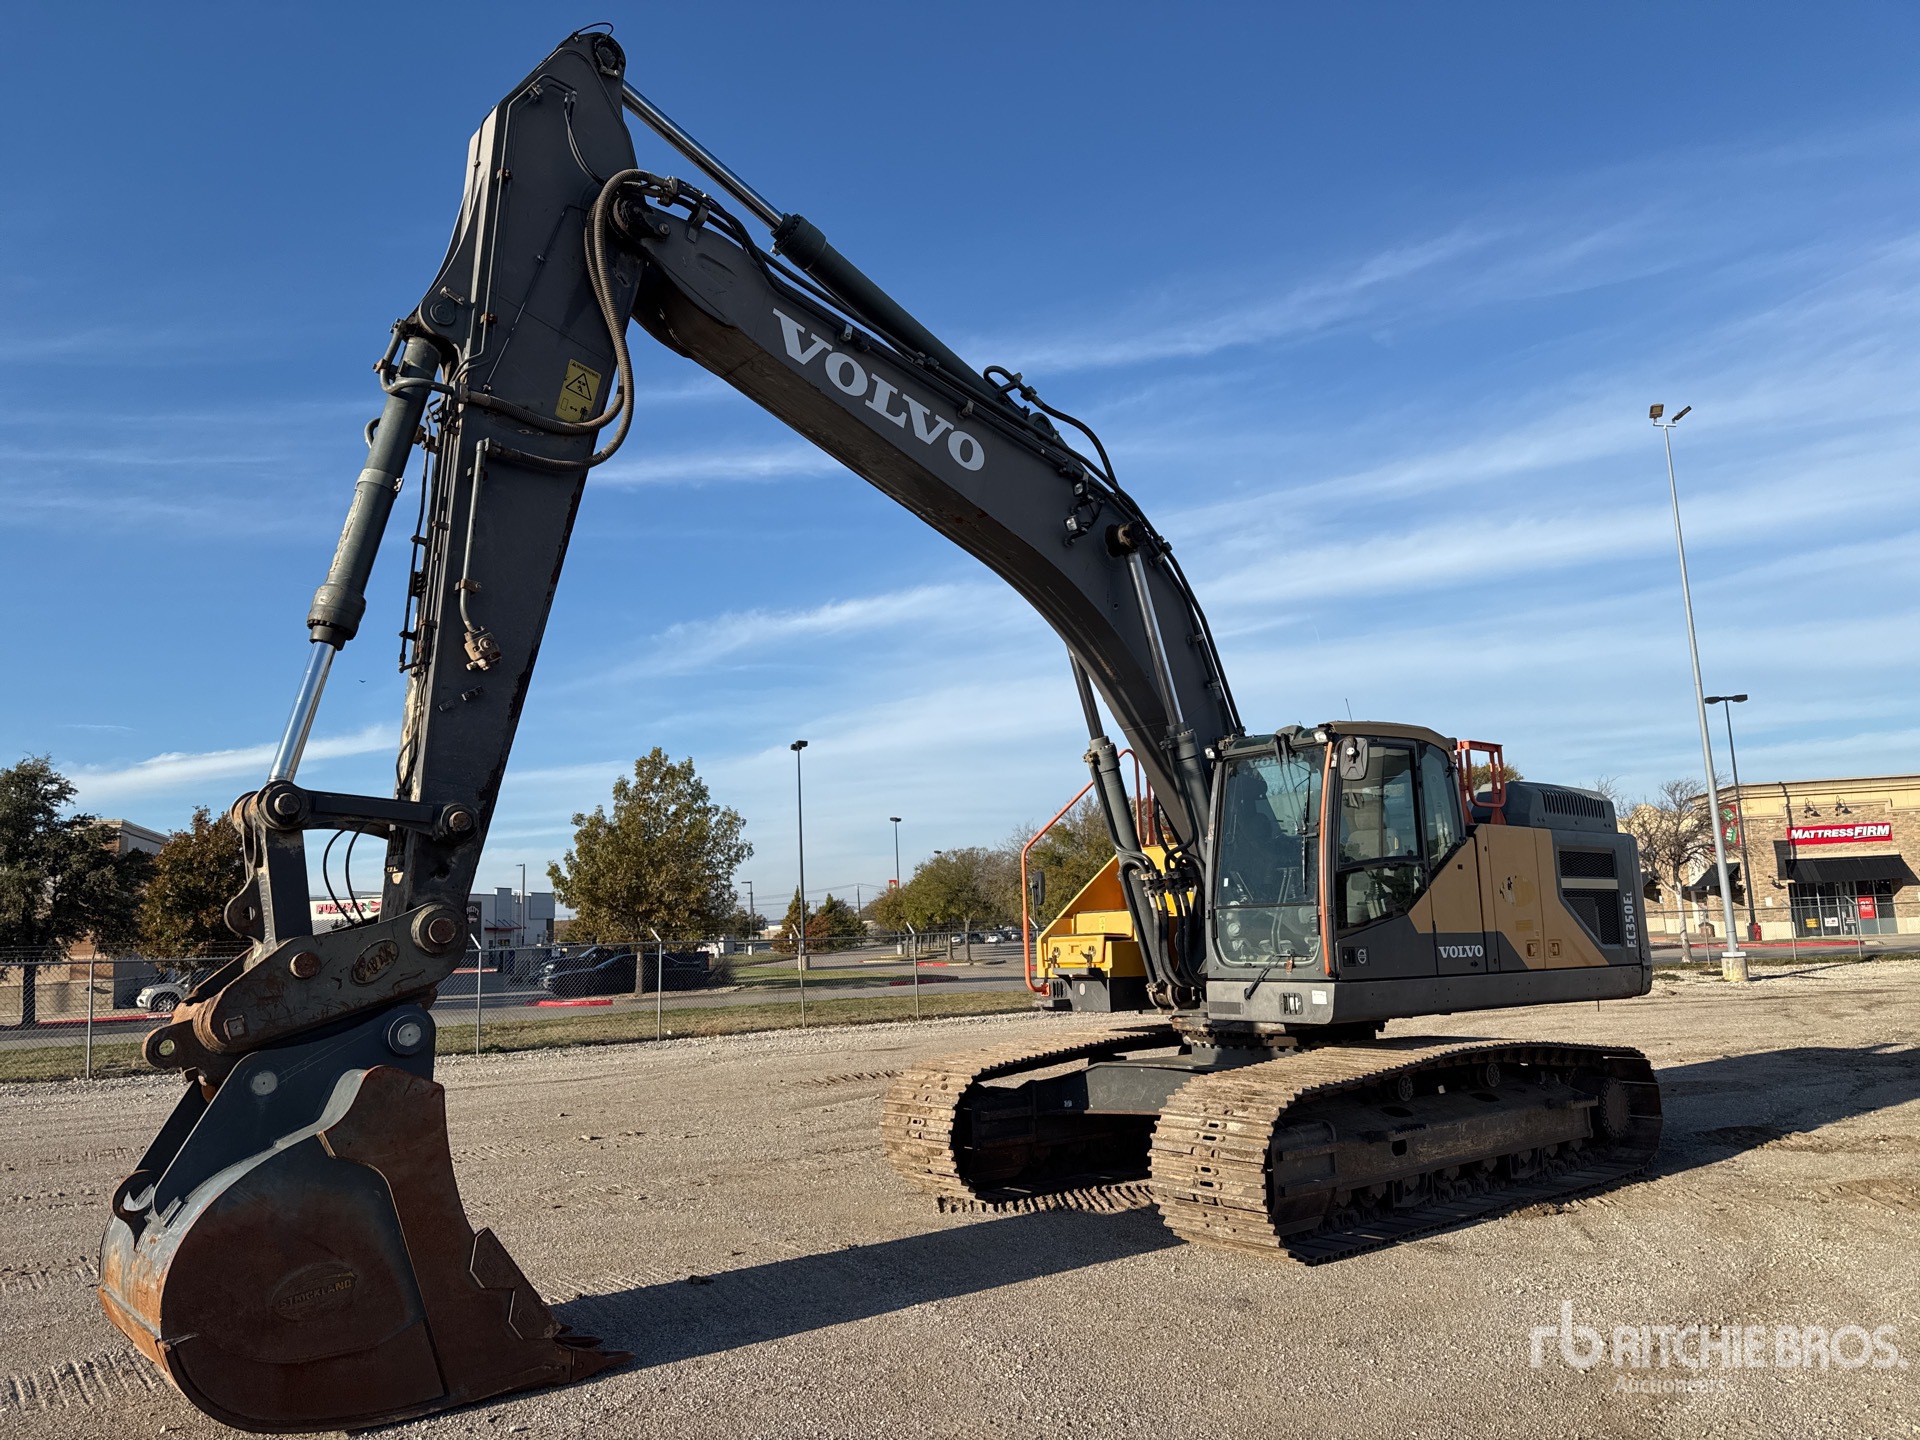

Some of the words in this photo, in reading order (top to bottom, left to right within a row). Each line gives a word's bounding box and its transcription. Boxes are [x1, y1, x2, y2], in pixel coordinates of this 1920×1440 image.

[772, 307, 985, 471] VOLVO
[1247, 752, 1304, 769] VOLO
[316, 901, 366, 914] FUZYS
[1438, 945, 1483, 958] VOLVO
[280, 1279, 352, 1307] STRICKLAND
